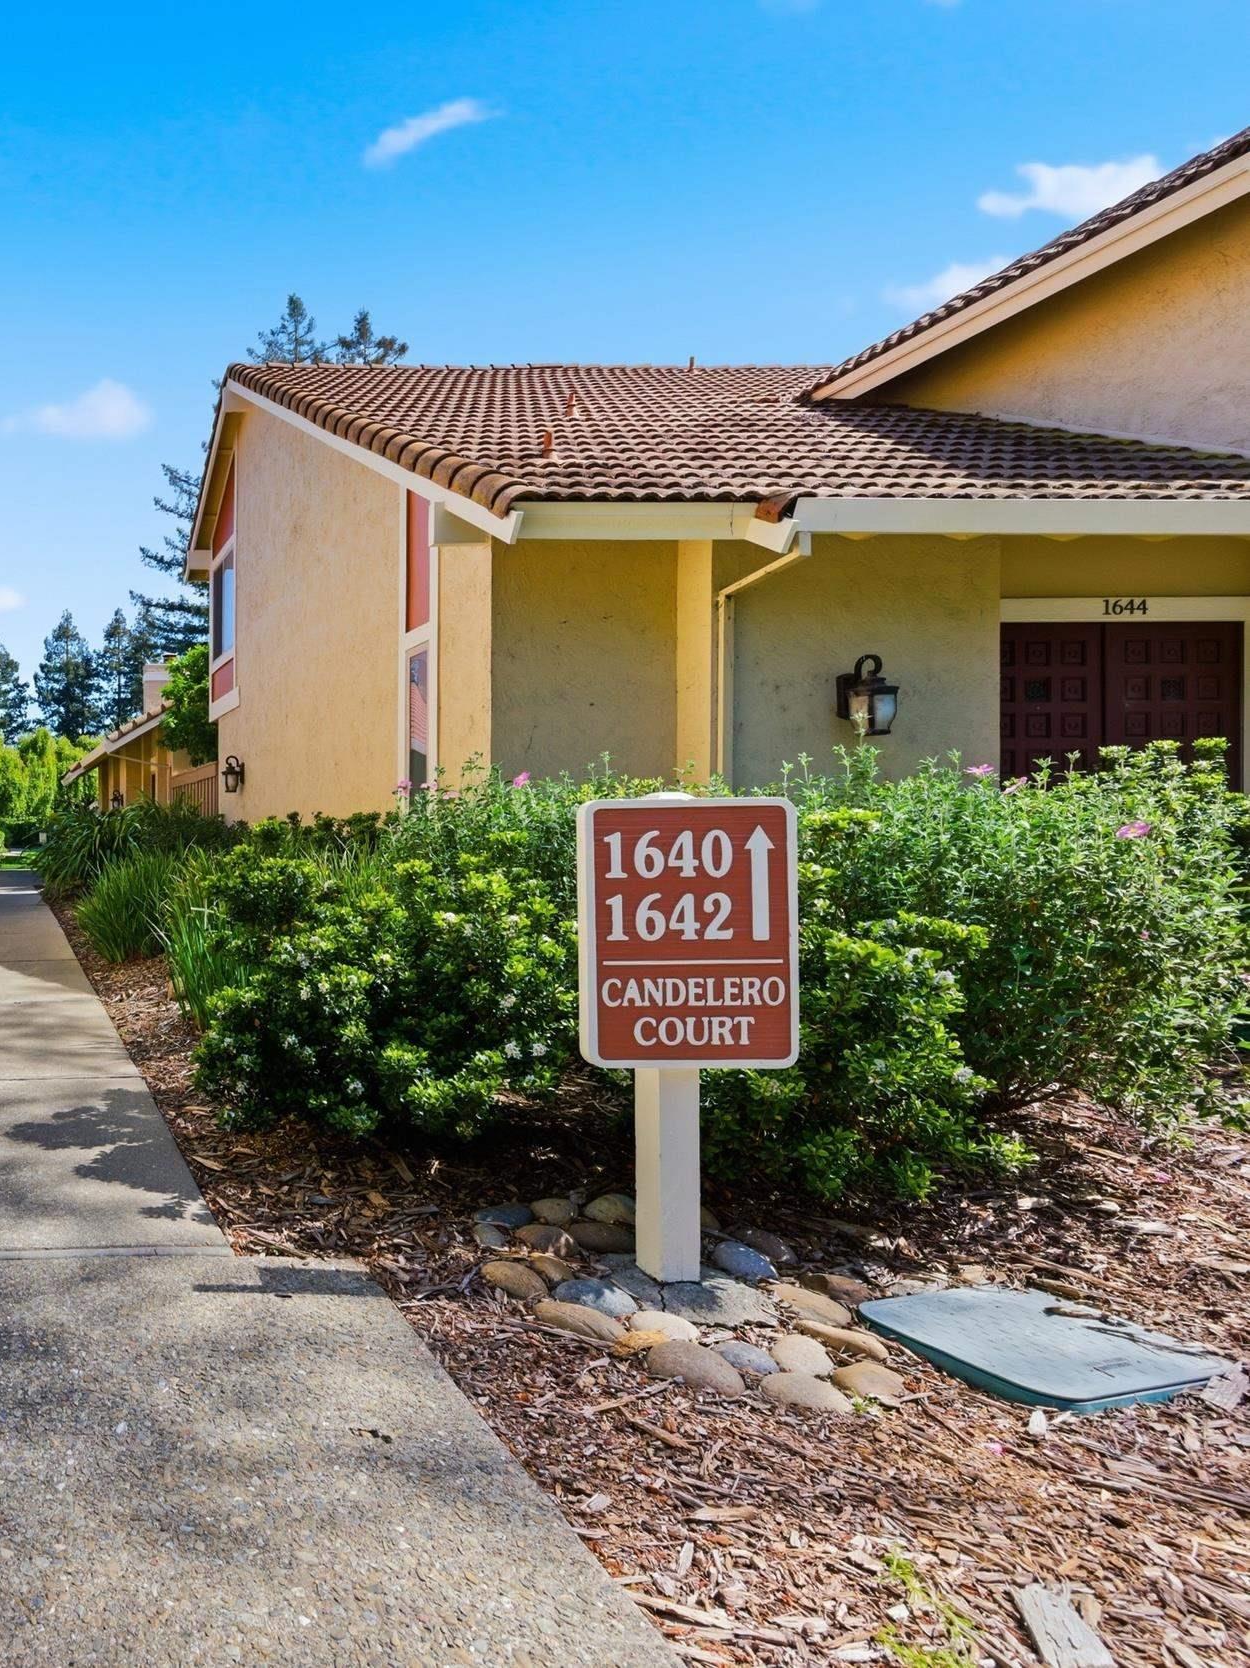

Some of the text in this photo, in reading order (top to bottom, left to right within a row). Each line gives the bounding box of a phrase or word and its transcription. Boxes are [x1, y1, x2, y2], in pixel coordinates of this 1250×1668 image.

[1102, 599, 1149, 616] 1644
[603, 829, 733, 879] 1640
[605, 892, 734, 942] 1642
[601, 976, 786, 1008] CANDELERO
[633, 1016, 755, 1046] COURT
